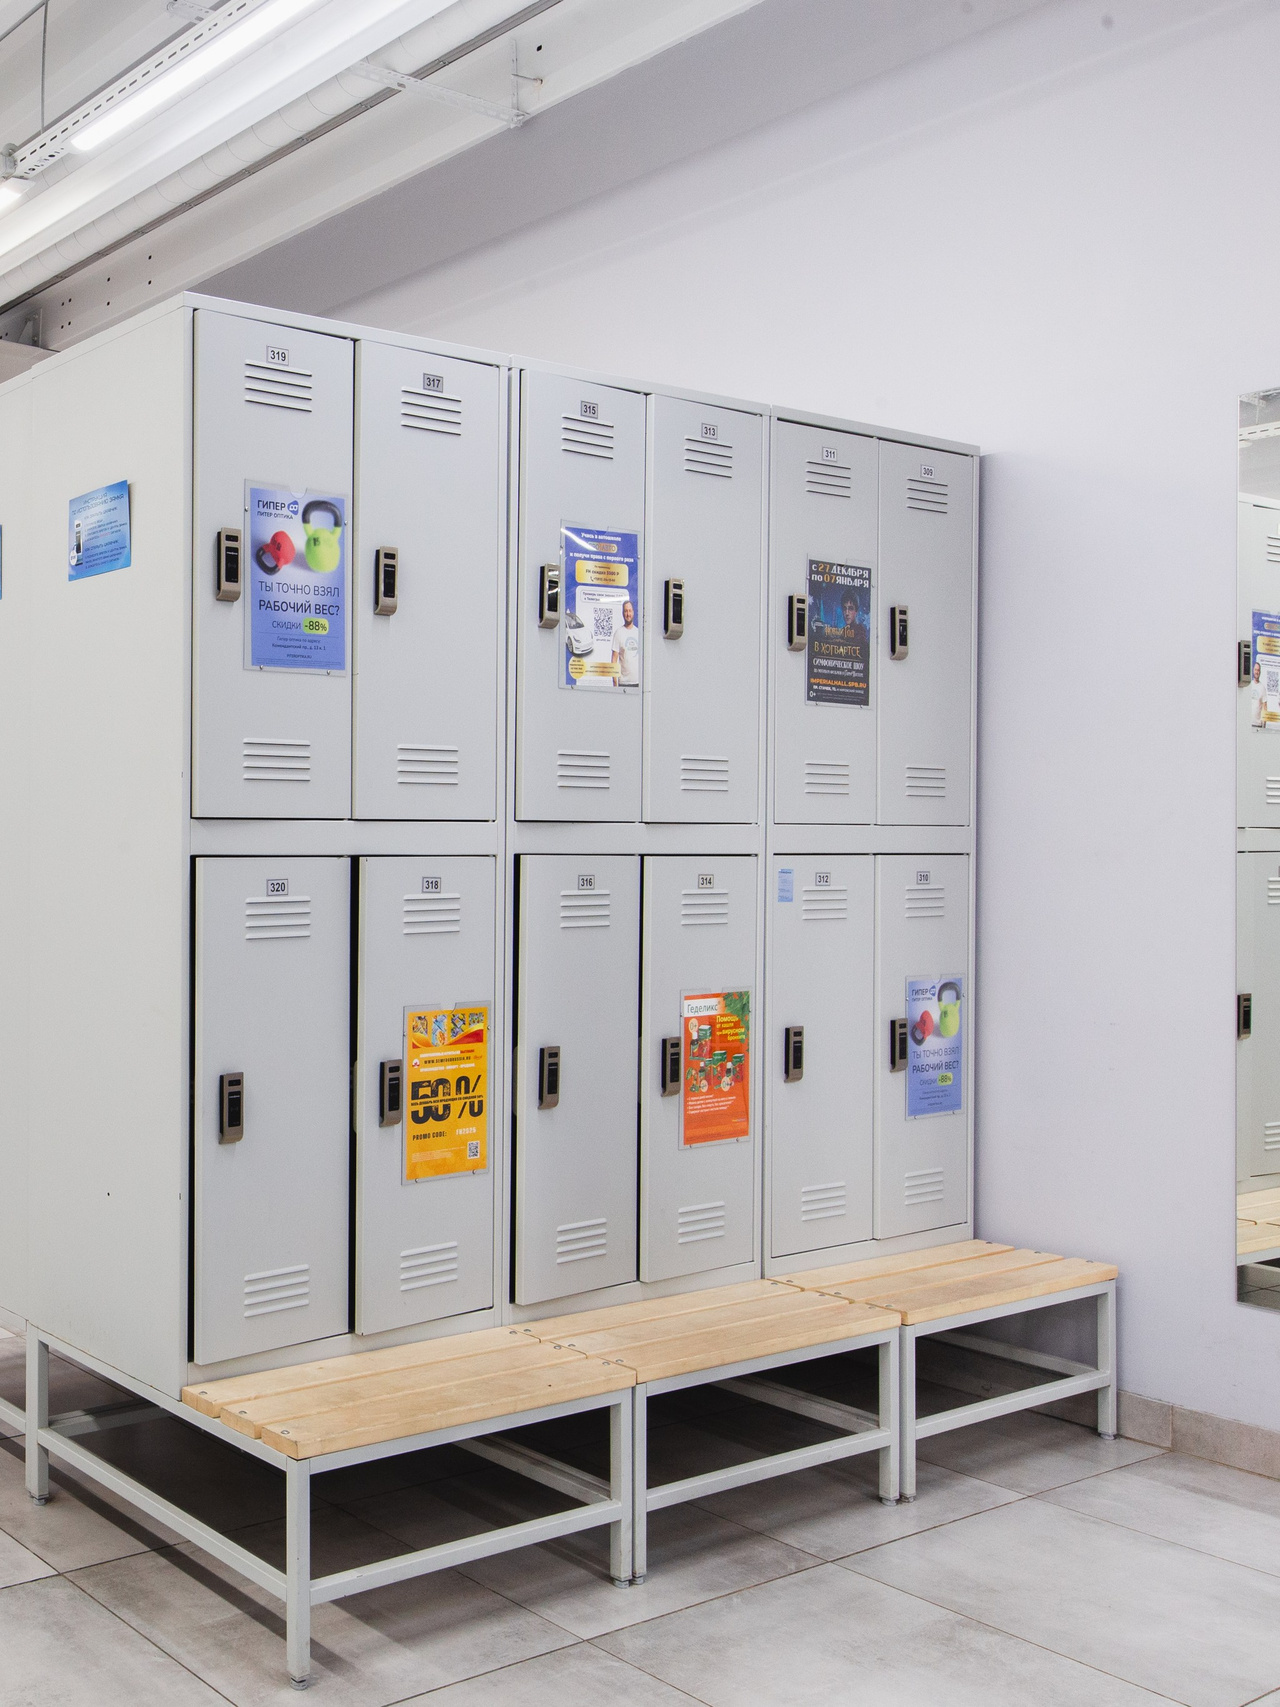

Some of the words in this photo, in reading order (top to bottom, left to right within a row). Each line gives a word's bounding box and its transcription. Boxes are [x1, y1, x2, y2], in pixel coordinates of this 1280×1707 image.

[270, 350, 286, 362] 319
[426, 377, 440, 388] 317
[584, 404, 596, 415] 315
[704, 426, 716, 437] 313
[825, 450, 835, 459] 311
[258, 500, 286, 510] ГИПЕР
[831, 565, 868, 578] ДЕКАБРЯ
[824, 574, 836, 583] 07
[836, 576, 869, 588] ЯНВАРЯ
[258, 581, 273, 592] ТЫ
[276, 582, 311, 595] ТОЧНО
[314, 585, 339, 597] ВЗЯЛ
[259, 600, 311, 614] РАБОЧИЙ
[315, 604, 340, 616] ВЕС?
[272, 620, 301, 630] СКИДКИ
[305, 620, 327, 631] -88%
[580, 878, 593, 887] 316
[700, 877, 712, 886] 314
[818, 875, 828, 884] 312
[919, 874, 928, 882] 310
[270, 882, 286, 892] 320
[425, 880, 438, 890] 318
[688, 1004, 718, 1014] Геделикс
[923, 1048, 943, 1057] ТОЧНО
[913, 1061, 943, 1073] РАБОЧИЙ
[944, 1060, 959, 1070] ВЕС?
